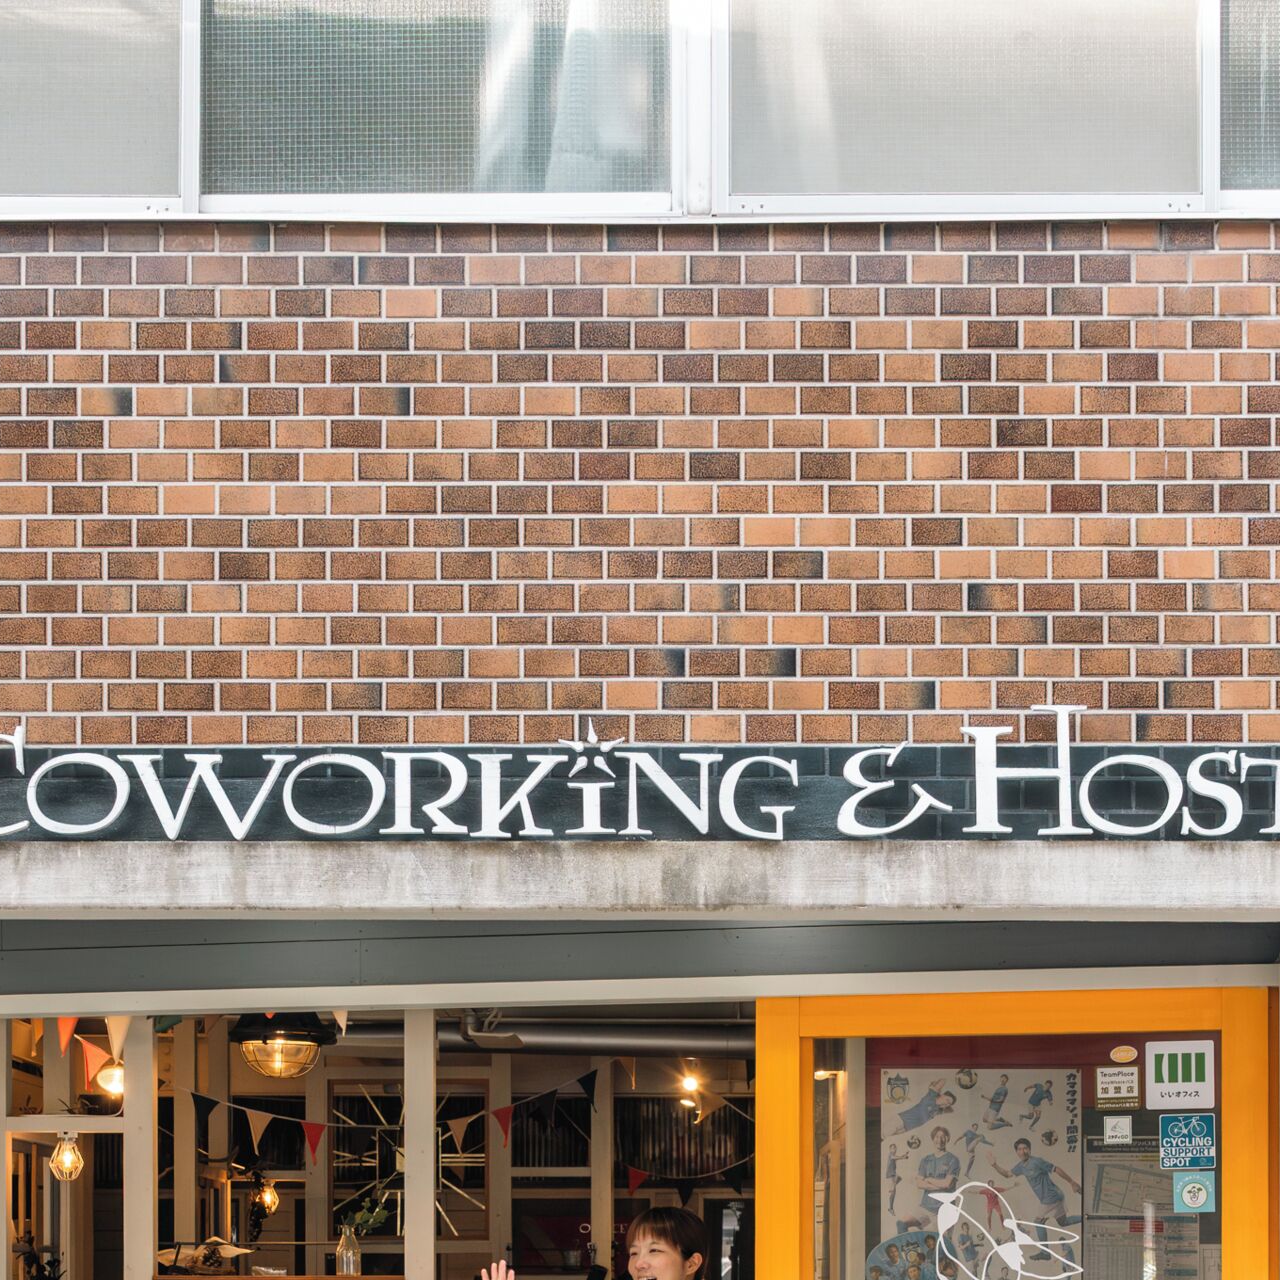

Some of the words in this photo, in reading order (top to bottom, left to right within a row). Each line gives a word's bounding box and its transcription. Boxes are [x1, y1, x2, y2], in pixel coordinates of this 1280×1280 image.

[836, 740, 953, 838] &
[1160, 1090, 1200, 1098] いいオフィス
[1163, 1136, 1212, 1147] CYCLING
[1163, 1147, 1212, 1157] SUPPORT
[1163, 1157, 1192, 1167] SPOT
